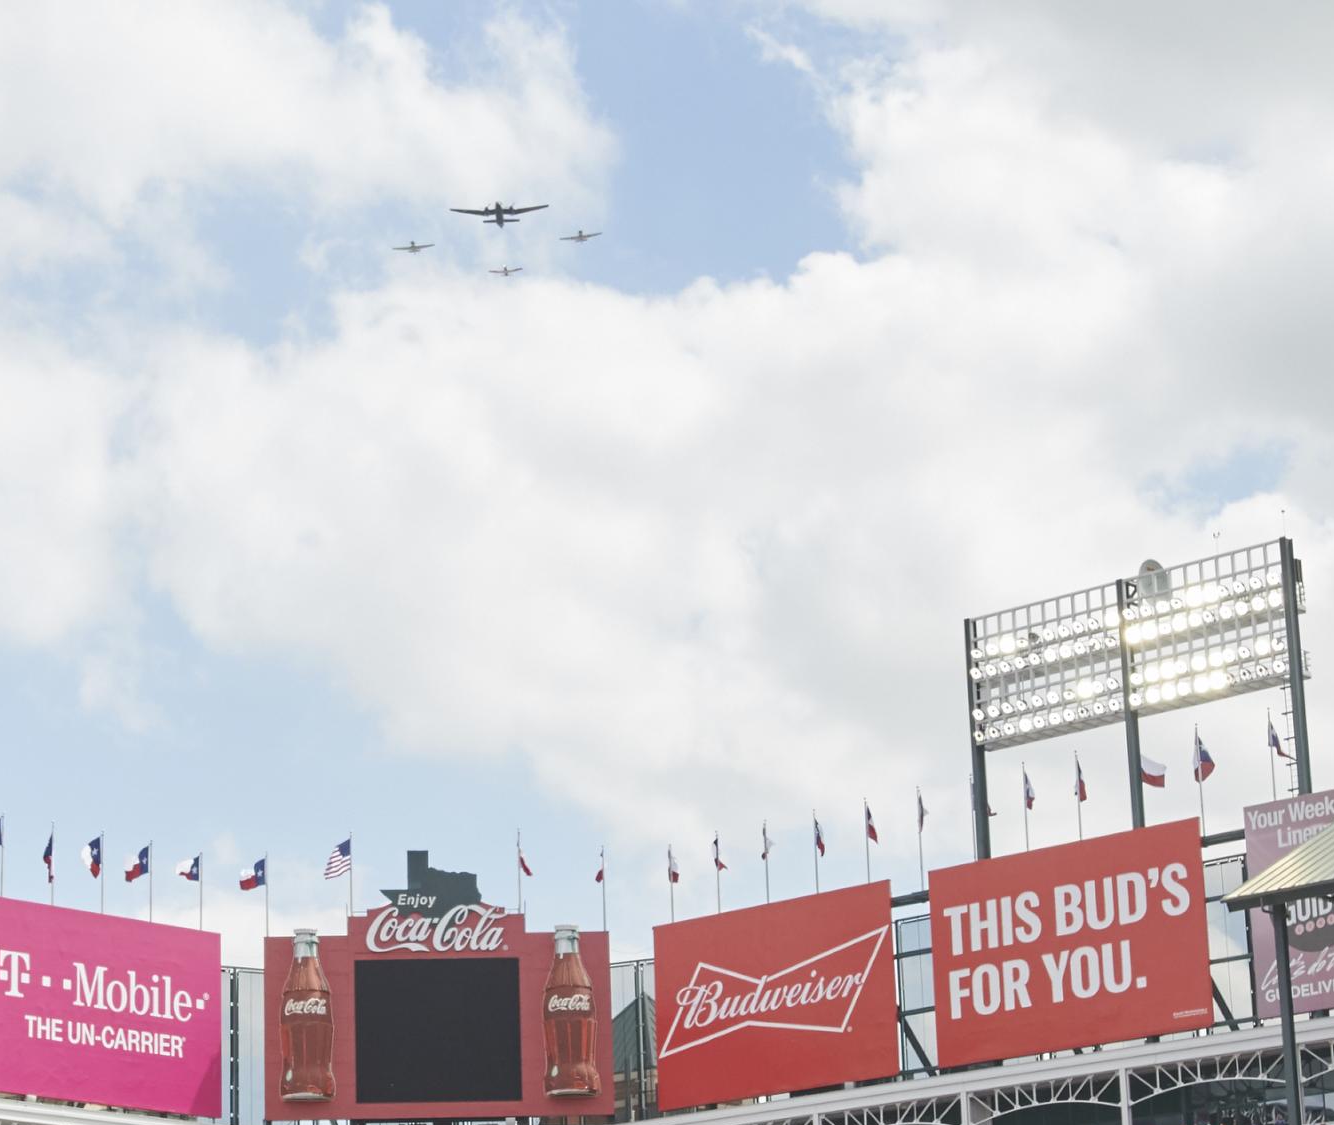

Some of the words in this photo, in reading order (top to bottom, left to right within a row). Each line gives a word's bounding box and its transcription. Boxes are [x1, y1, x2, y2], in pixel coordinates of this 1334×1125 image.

[1247, 809, 1285, 830] Your
[397, 893, 436, 908] Enjoy
[943, 890, 1043, 956] THIS
[1054, 862, 1191, 937] BUD'S
[676, 970, 865, 1029] Budweiser
[949, 958, 1033, 1020] FOR
[1042, 939, 1148, 1004] YOU.
[24, 1015, 63, 1042] THE
[67, 1021, 184, 1058] UN-CARRIER
